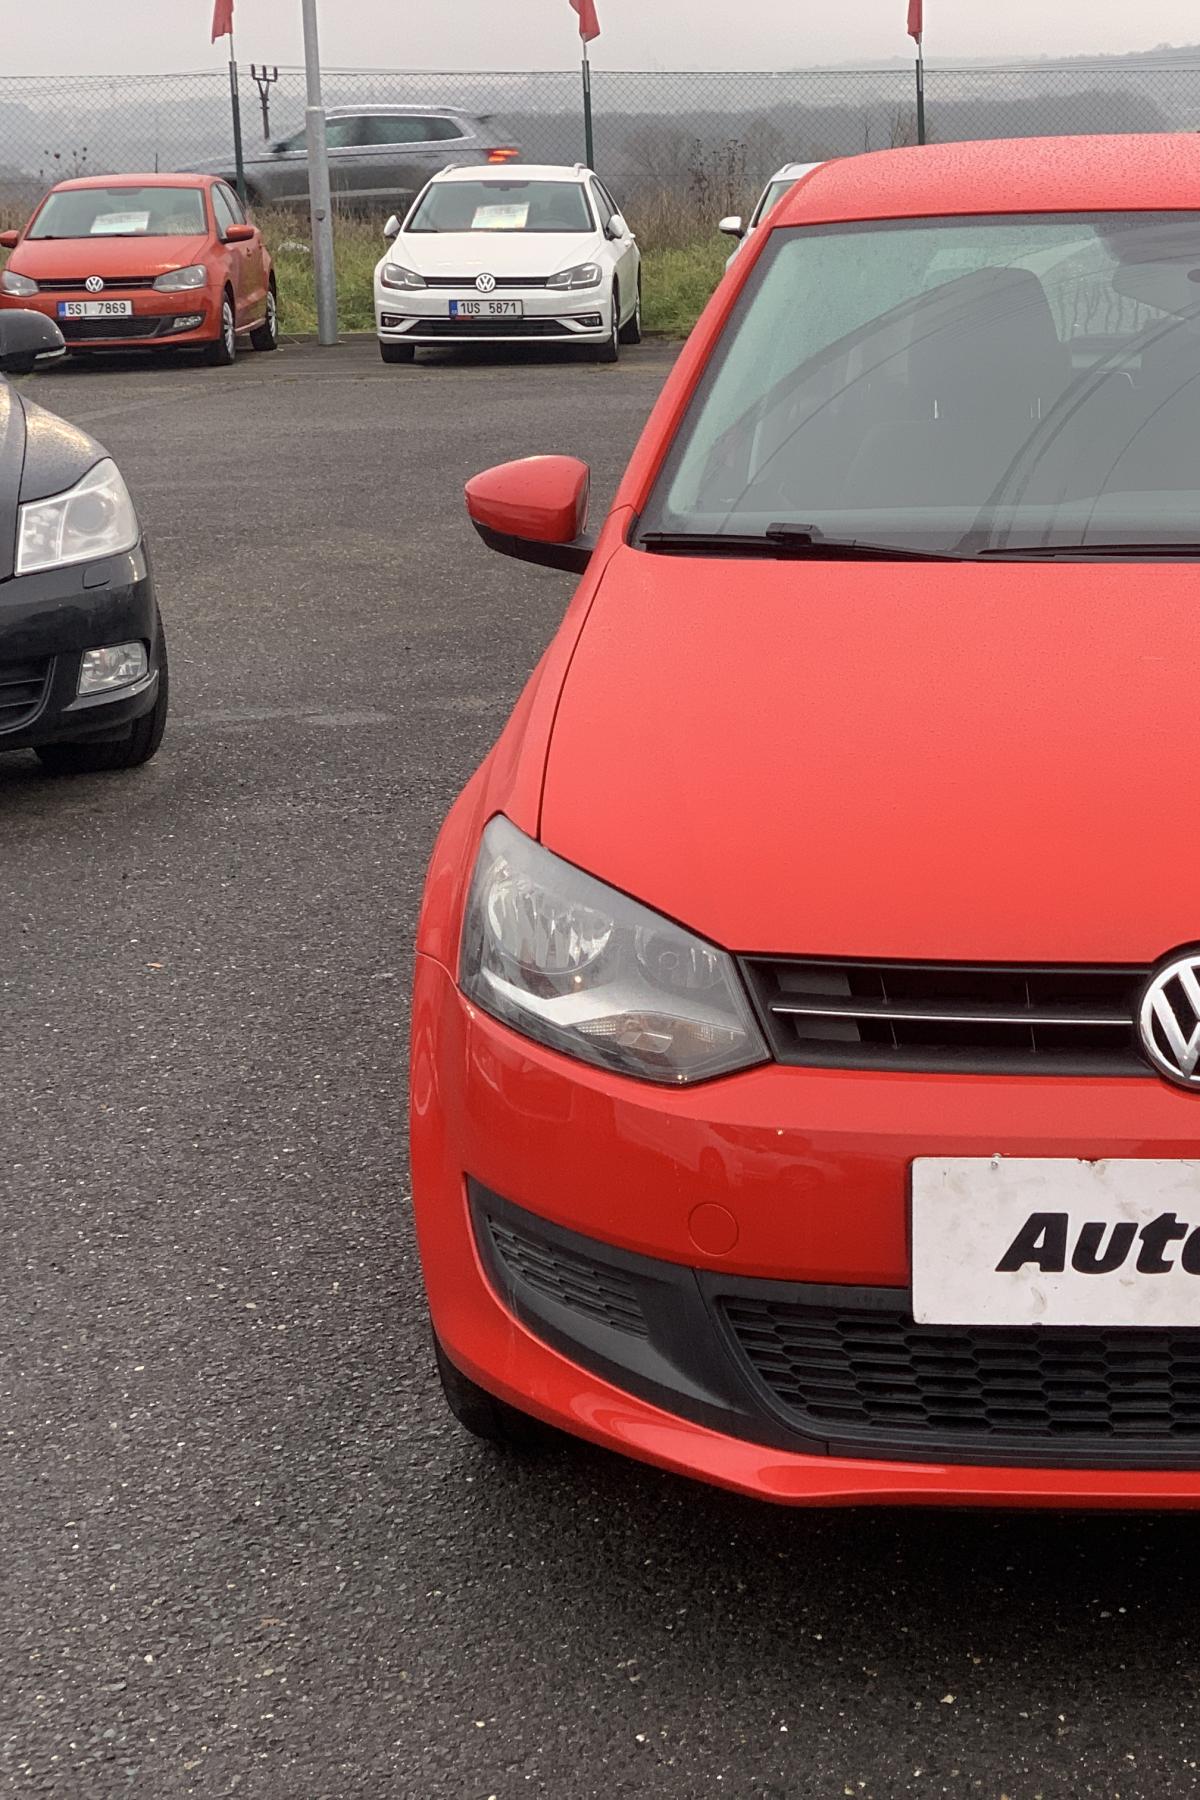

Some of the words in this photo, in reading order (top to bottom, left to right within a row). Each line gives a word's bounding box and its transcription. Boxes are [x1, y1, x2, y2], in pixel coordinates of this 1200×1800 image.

[67, 303, 87, 315] 5SI
[97, 302, 126, 314] 7869
[460, 302, 481, 314] 1US
[488, 302, 517, 314] 5871
